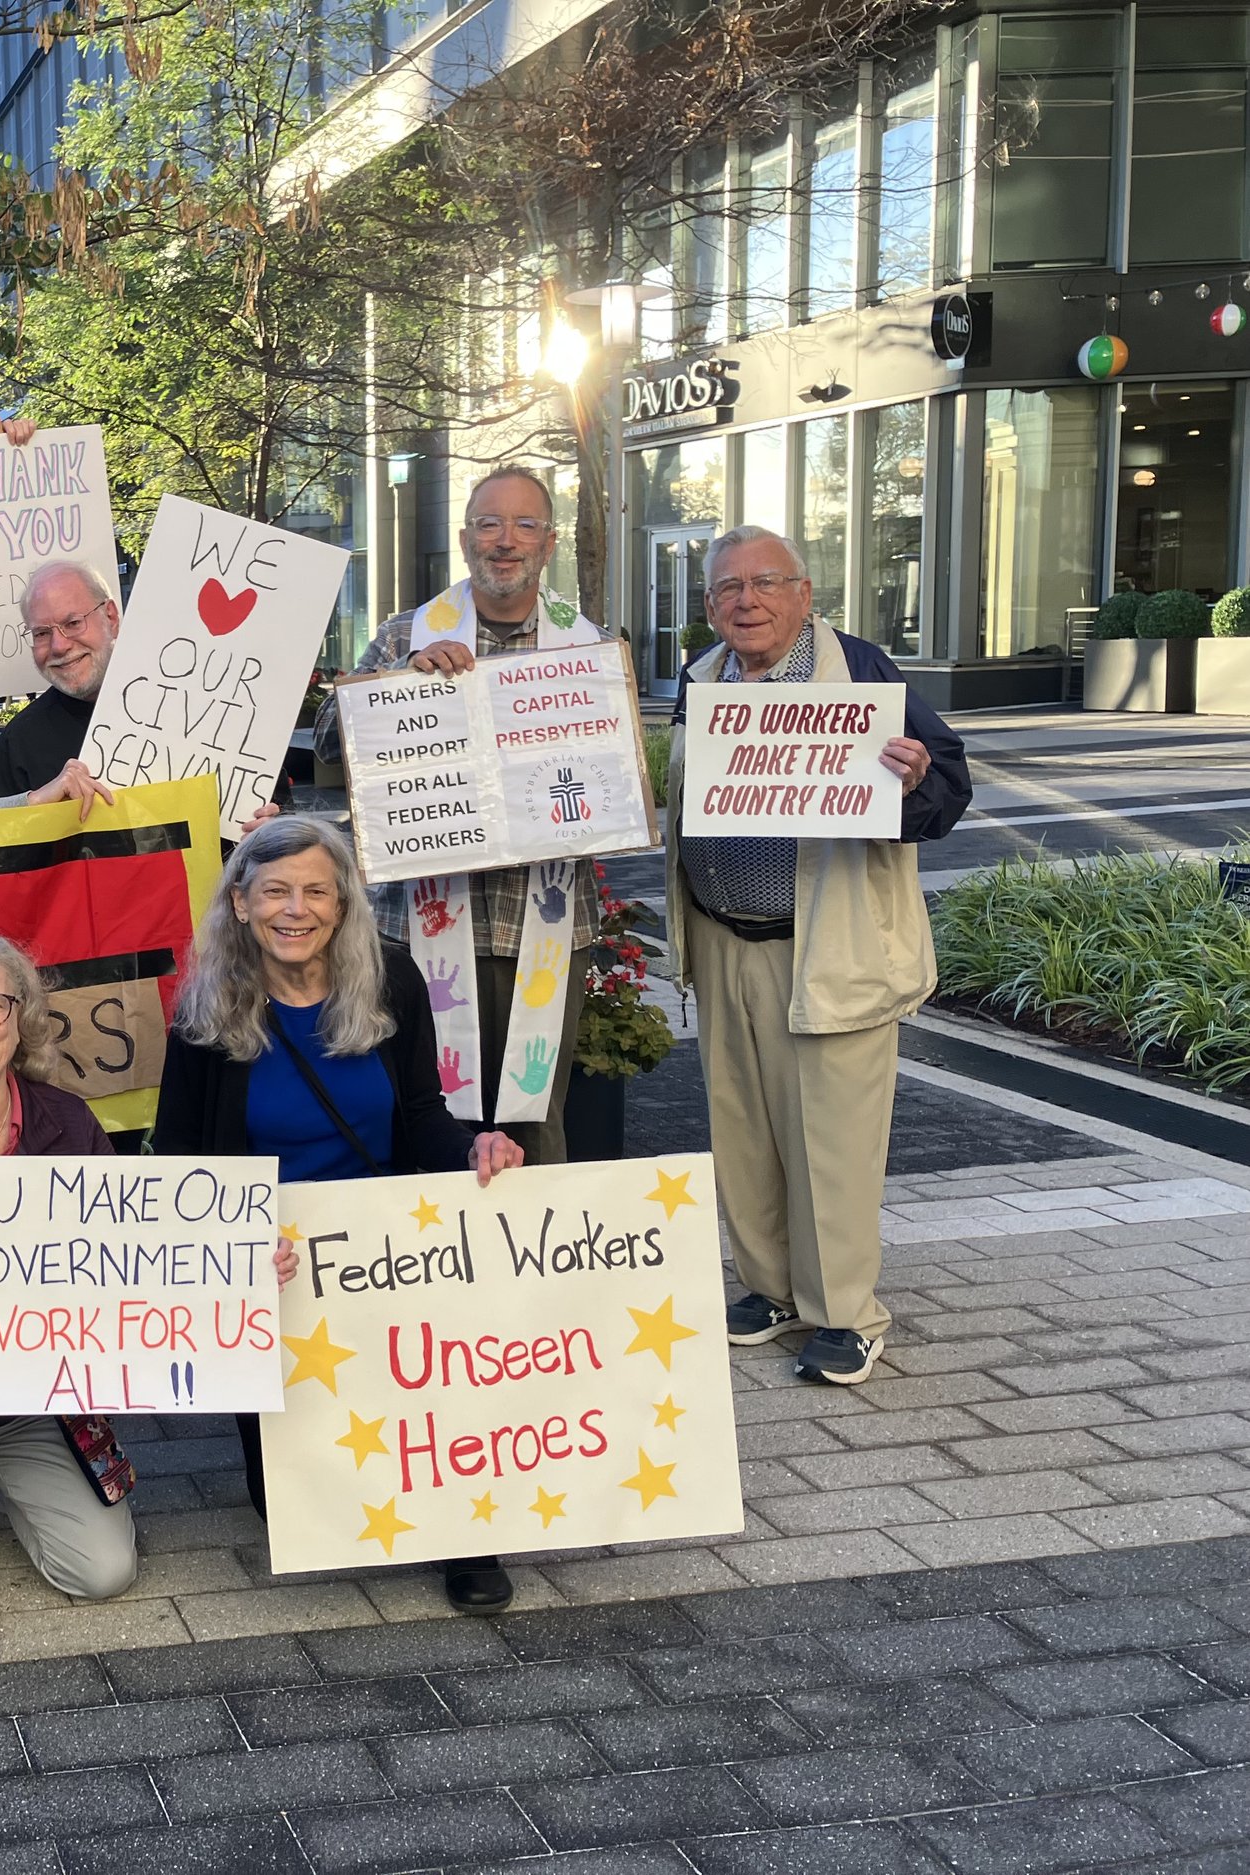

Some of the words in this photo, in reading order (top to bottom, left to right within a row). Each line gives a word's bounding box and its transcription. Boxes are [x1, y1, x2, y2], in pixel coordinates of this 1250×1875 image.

[622, 358, 716, 421] DAVIO'S
[190, 511, 286, 591] WE
[158, 637, 262, 706] OUR
[499, 659, 599, 686] NATIONAL
[368, 680, 457, 707] PRAYERS
[512, 690, 594, 715] CAPITAL
[122, 676, 267, 761] CIVIL
[395, 714, 439, 735] AND
[496, 718, 619, 748] PRESBYTERY
[708, 703, 751, 735] FED
[760, 703, 877, 734] WORKERS
[376, 738, 468, 766] SUPPORT
[726, 744, 802, 775] MAKE
[805, 744, 854, 775] THE
[387, 776, 427, 796] FOR
[432, 771, 468, 790] ALL
[590, 764, 611, 812] CHURCH
[387, 800, 477, 826] FEDERAL
[703, 785, 817, 816] COUNTRY
[820, 785, 873, 816] RUN
[384, 828, 486, 855] WORKERS
[555, 826, 594, 838] (USA)
[49, 1165, 163, 1225] MAKE
[174, 1168, 272, 1225] OUR
[308, 1210, 475, 1298] Federal
[497, 1206, 665, 1277] Workers
[119, 1300, 198, 1352] FOR
[214, 1298, 275, 1351] US
[388, 1322, 603, 1389] Unseen
[45, 1355, 156, 1413] ALL
[170, 1361, 194, 1406] !!
[398, 1408, 608, 1493] Heroes
